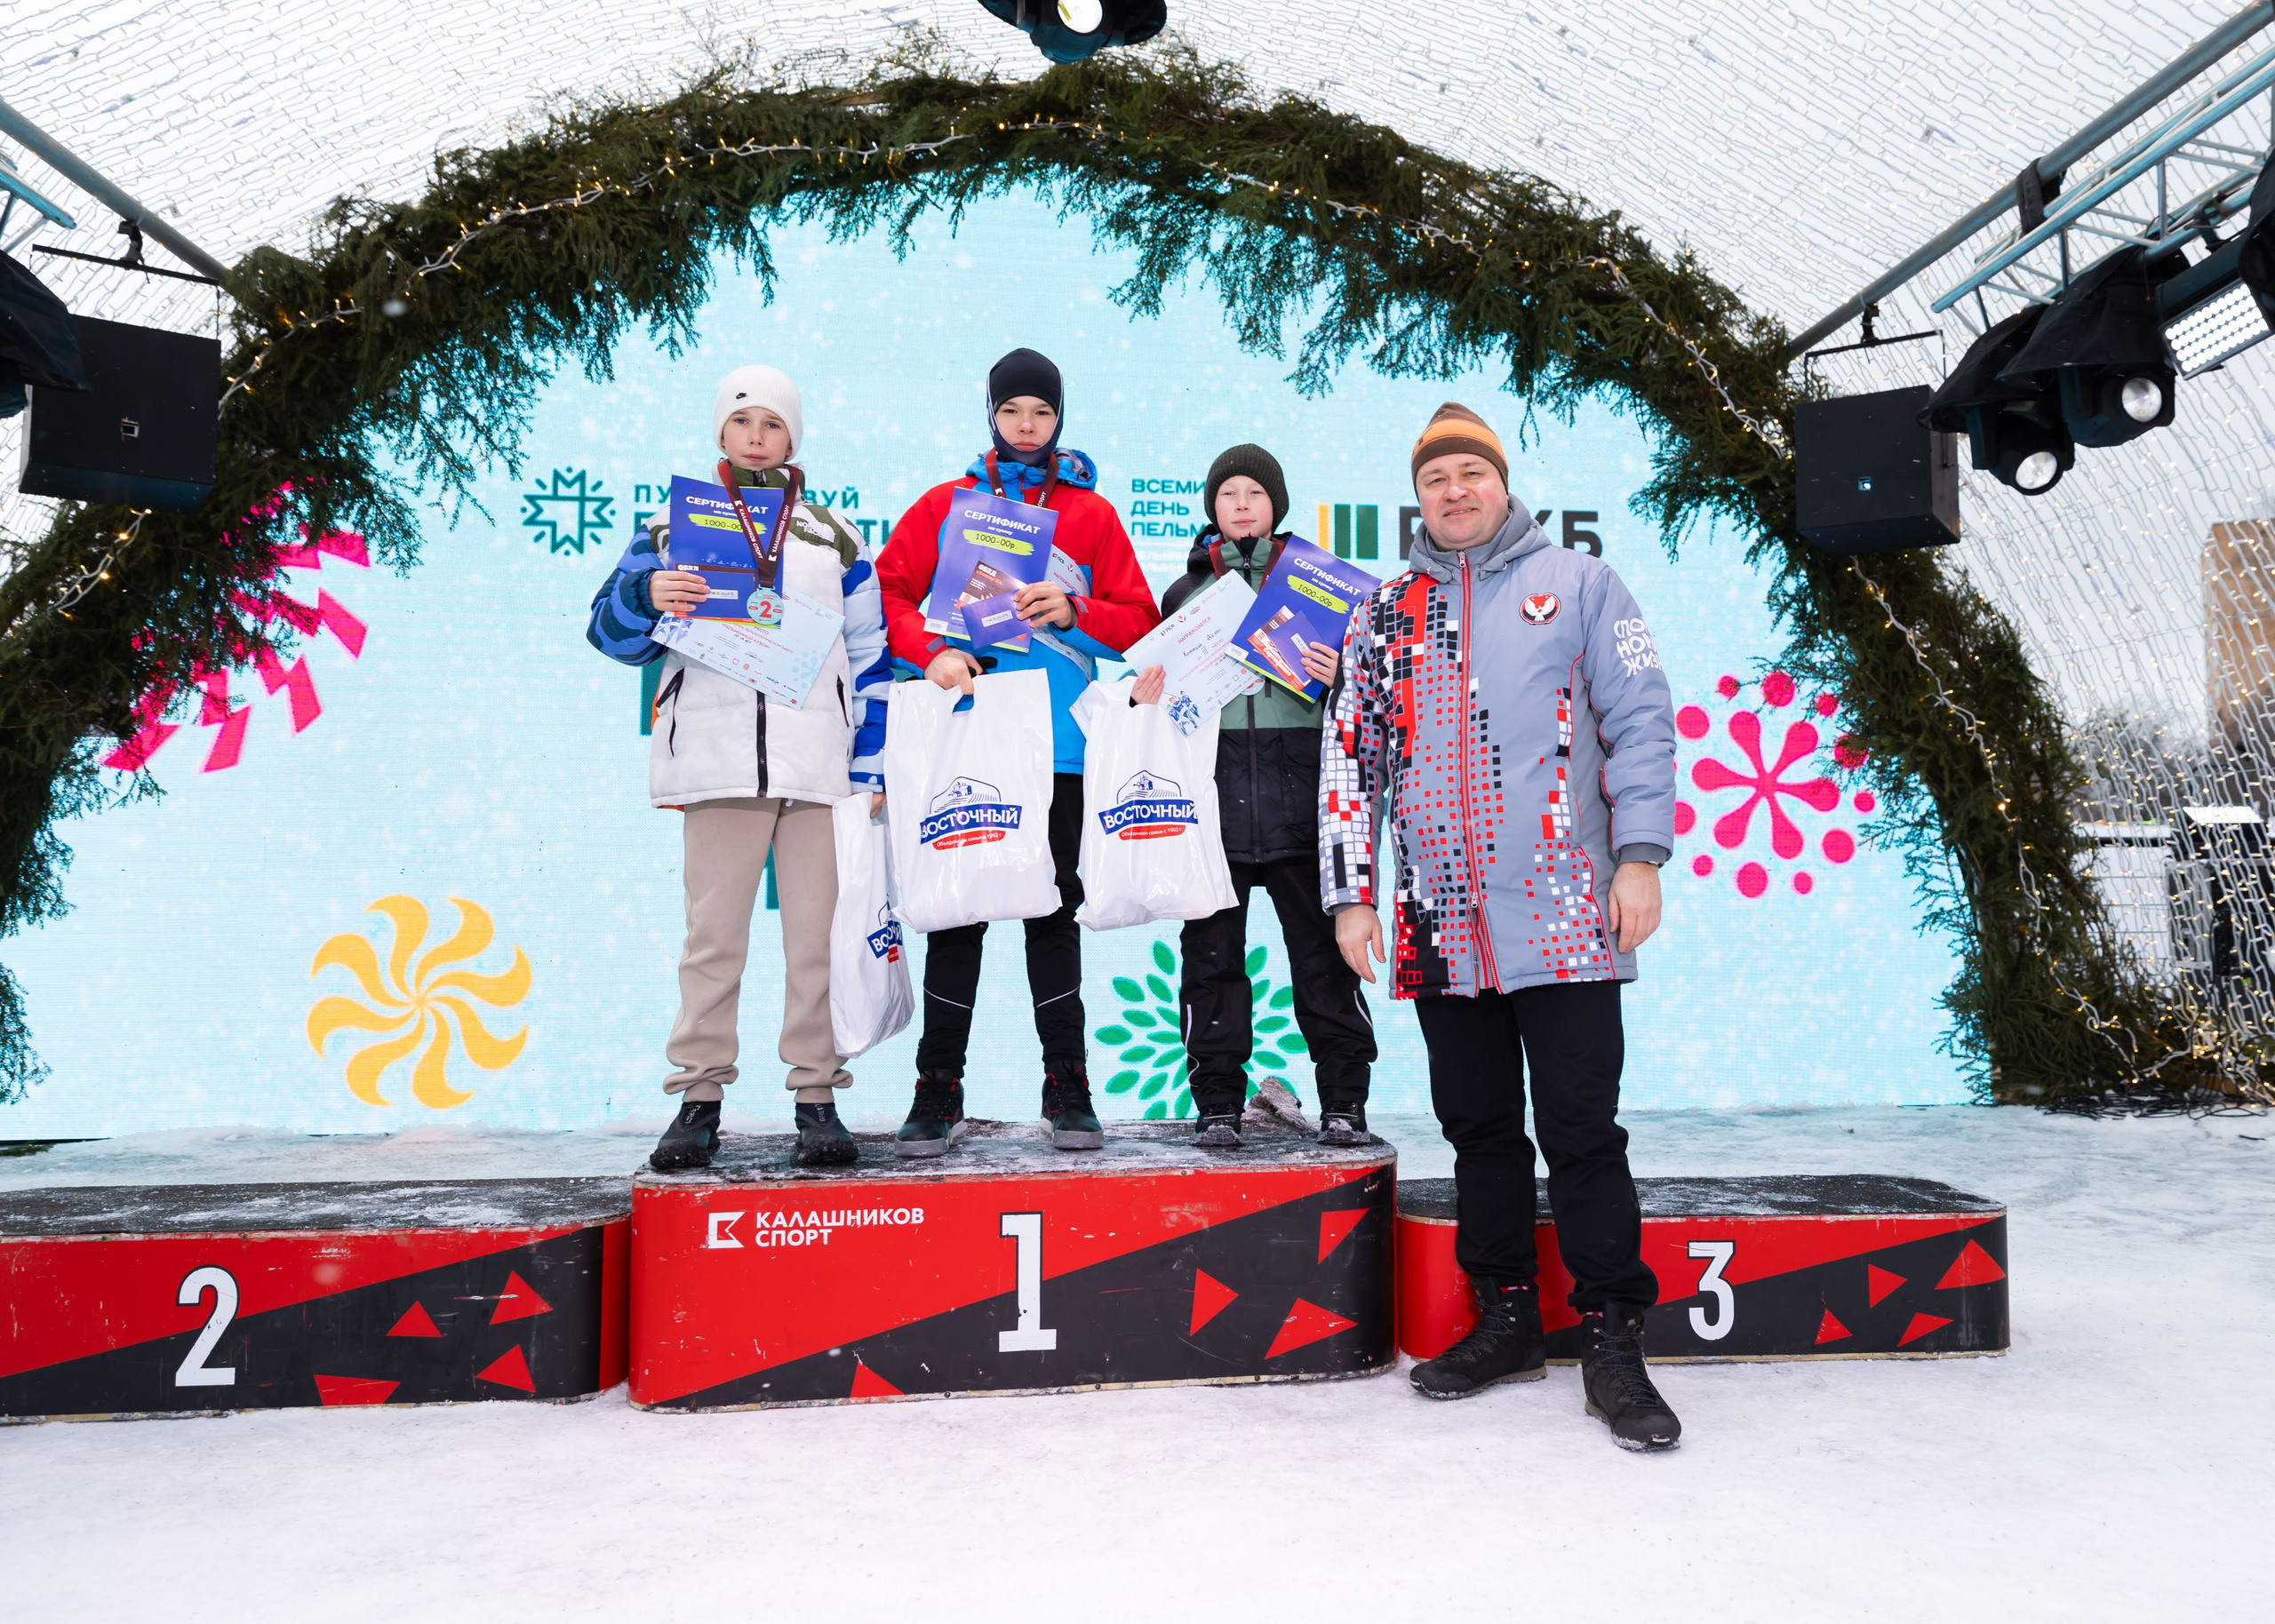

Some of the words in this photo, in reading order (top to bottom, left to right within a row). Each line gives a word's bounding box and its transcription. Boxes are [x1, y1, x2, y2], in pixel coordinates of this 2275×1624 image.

[1131, 479, 1206, 494] ВСЕМИ
[686, 496, 769, 514] СЕРТИФКАТ
[781, 505, 791, 520] СПОРТ
[1130, 500, 1190, 517] ДЕНЬ
[705, 519, 743, 531] 1000-00
[964, 509, 1041, 535] СЕРТИФИКАТ
[1131, 521, 1205, 537] ПЕЛЬМ
[1294, 557, 1361, 596] СЕРТИФИКАТ
[759, 601, 772, 618] 2
[1165, 624, 1176, 633] ПСБ
[922, 808, 1018, 839] ВОСТОЧНЫЙ
[1104, 802, 1197, 829] ВОСТОЧНЫЙ
[756, 1208, 924, 1229] КАЛАШНИКОВ
[755, 1229, 833, 1247] СПОРТ
[999, 1213, 1057, 1352] 1
[1688, 1241, 1735, 1341] 3
[175, 1266, 238, 1386] 2
